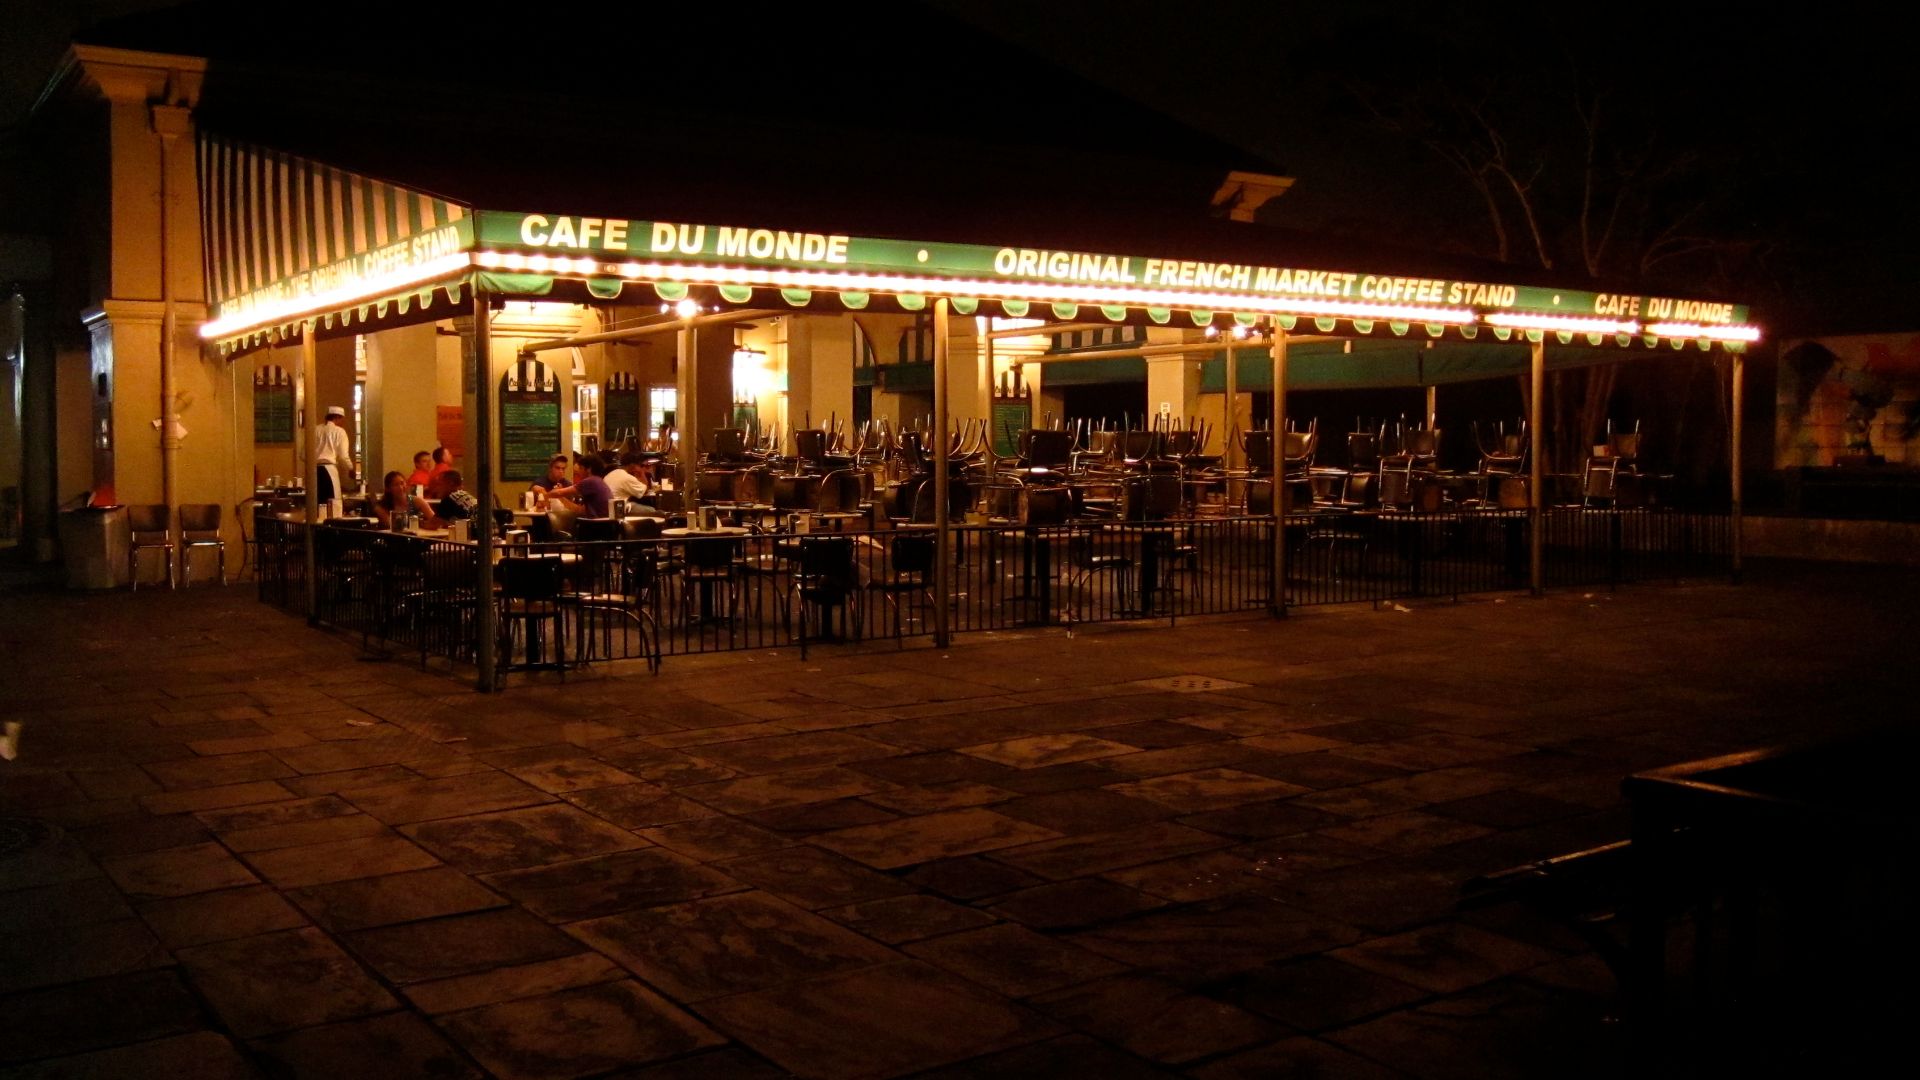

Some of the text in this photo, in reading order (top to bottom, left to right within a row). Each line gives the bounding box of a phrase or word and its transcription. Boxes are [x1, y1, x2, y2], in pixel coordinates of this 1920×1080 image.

[363, 240, 410, 279] COFFEE
[412, 225, 461, 264] STAND
[520, 214, 850, 264] CAFE DU MONDE
[994, 247, 1517, 308] ORIGINAL FRENCH MARKET COFFEE STAND
[1595, 293, 1734, 323] CAFE DU MONDE
